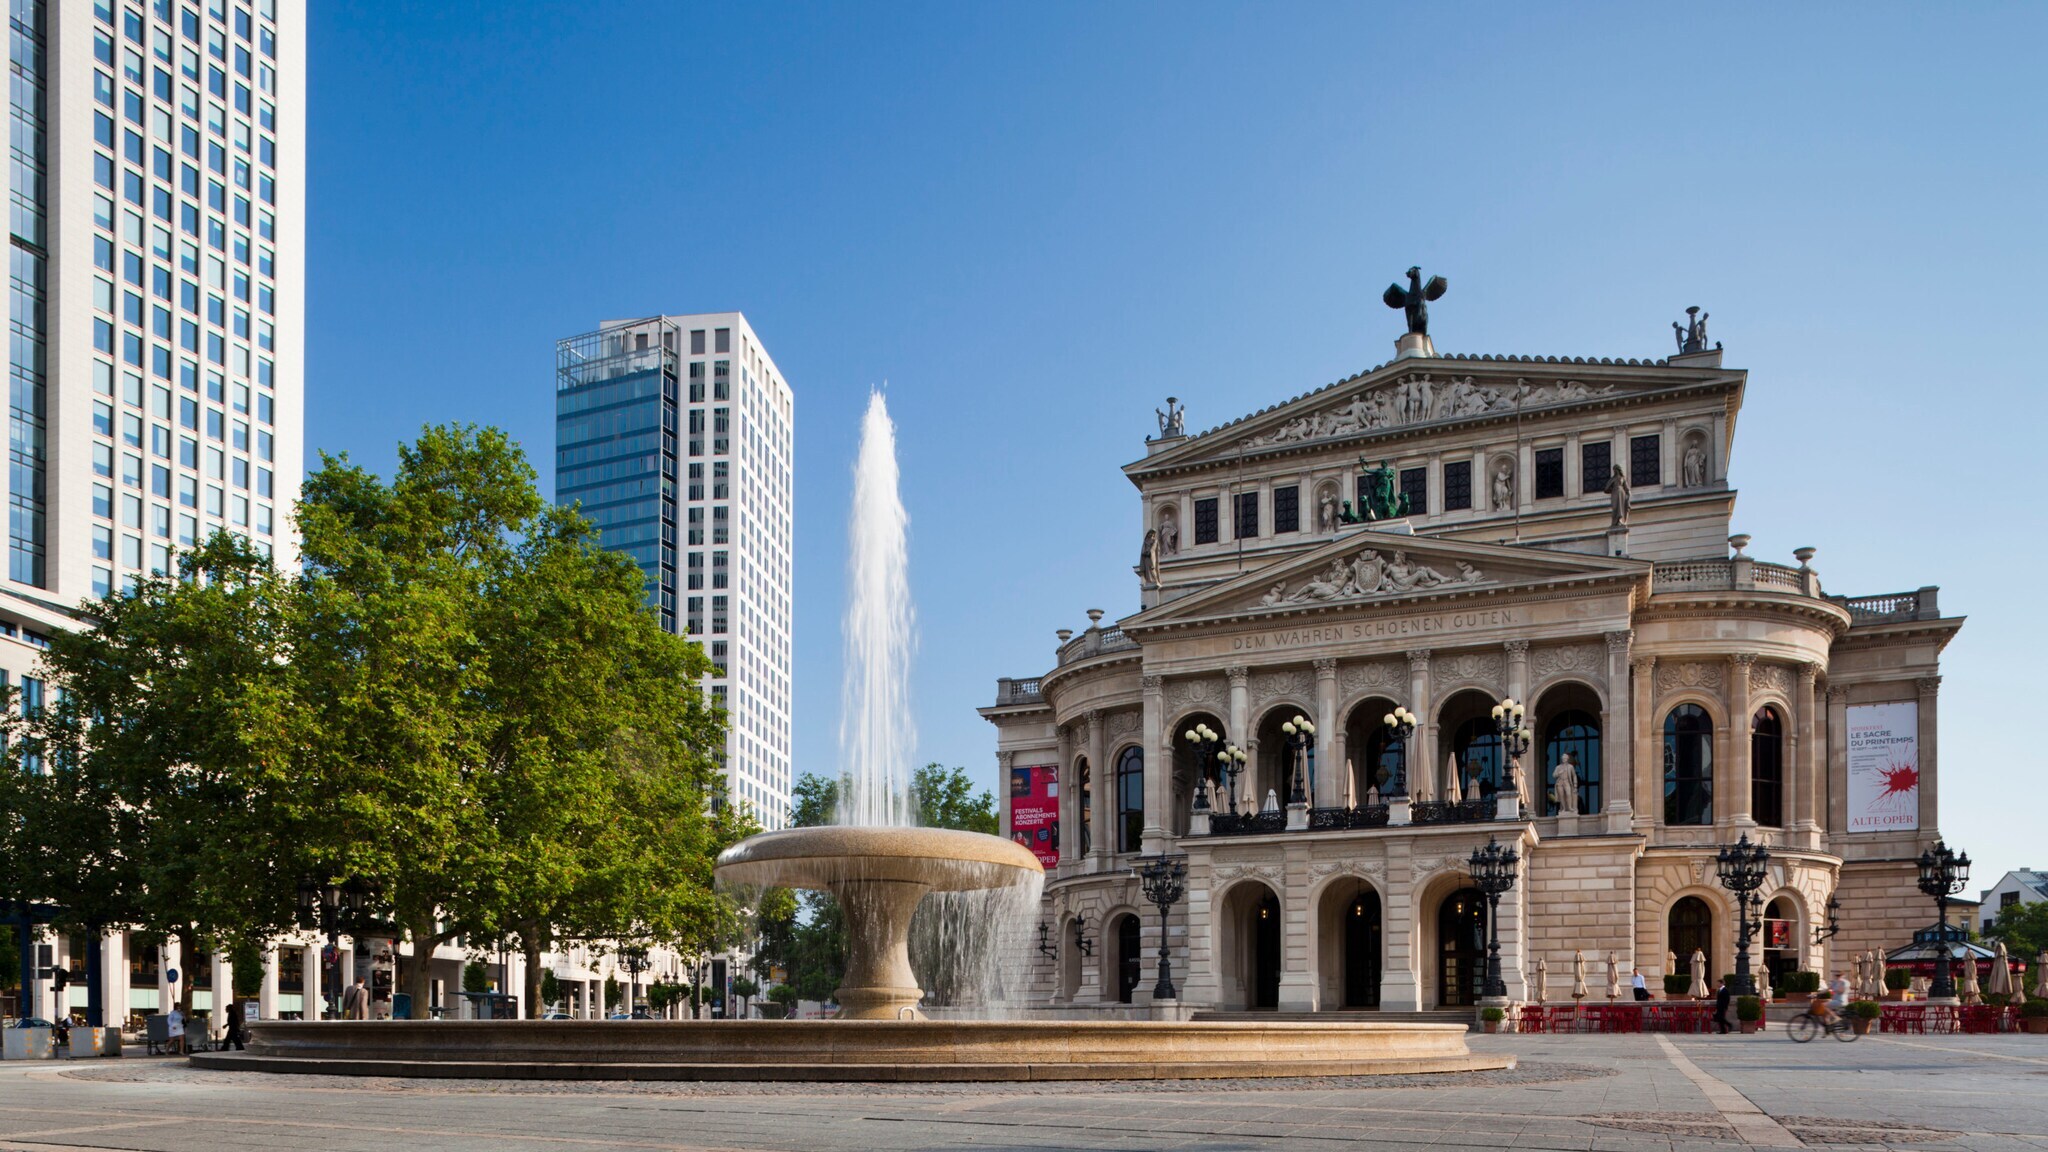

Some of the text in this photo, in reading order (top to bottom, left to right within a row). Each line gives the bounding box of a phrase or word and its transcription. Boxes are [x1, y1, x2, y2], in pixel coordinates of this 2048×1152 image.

[1233, 636, 1266, 650] DEM
[1273, 627, 1343, 646] WAHREN
[1353, 616, 1443, 637] SCHOENEN
[1863, 730, 1892, 738] SACRE
[1865, 736, 1914, 745] PRINTEMPS
[1015, 812, 1057, 820] ABONNEMENTS
[1015, 818, 1044, 826] KONZERTE
[1851, 815, 1914, 826] ALTE OPER
